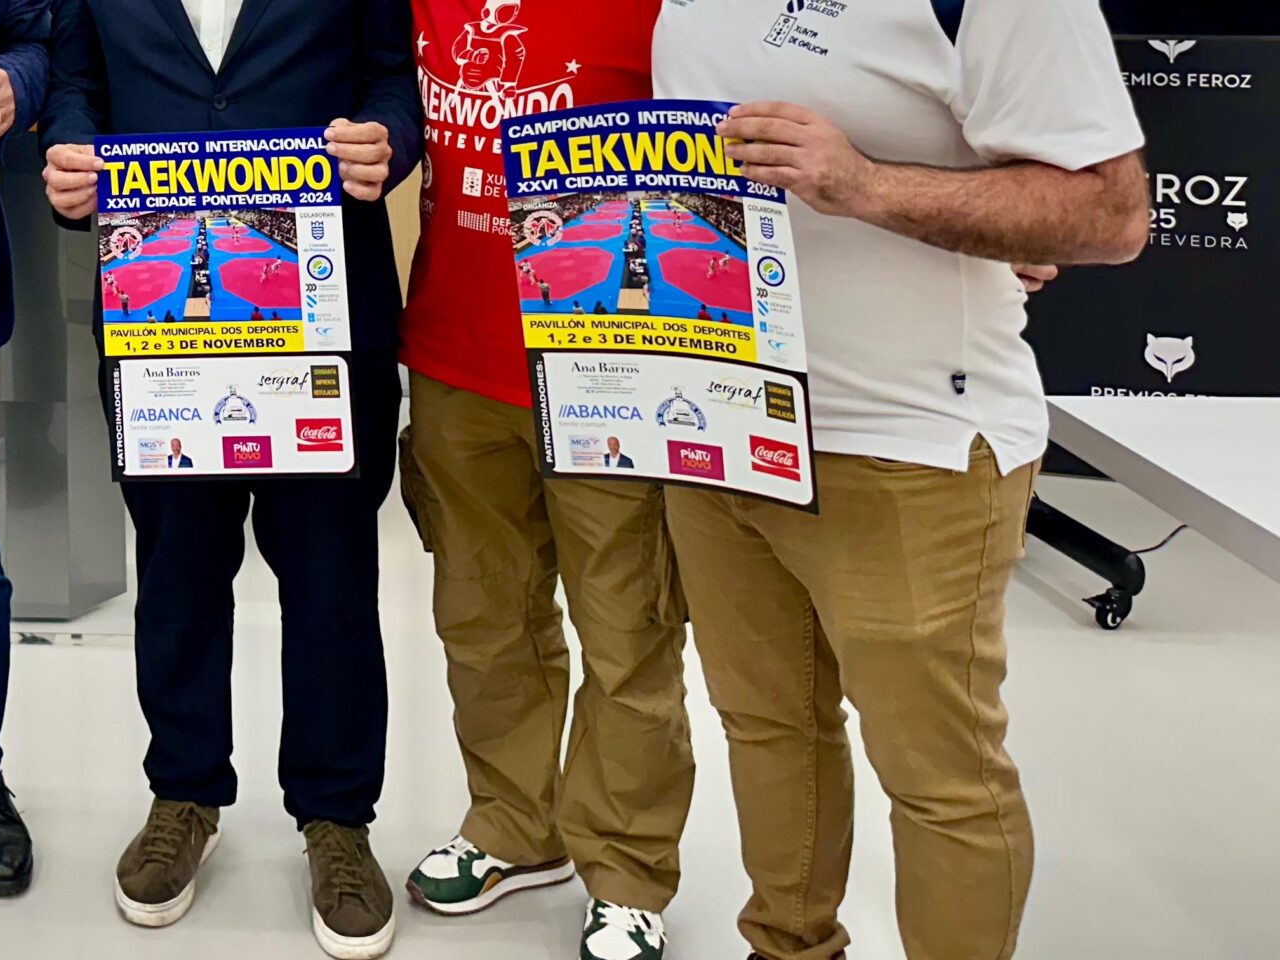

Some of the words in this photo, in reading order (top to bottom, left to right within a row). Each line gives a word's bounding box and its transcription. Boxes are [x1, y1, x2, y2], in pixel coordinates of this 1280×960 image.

[806, 3, 839, 18] GALEGO
[788, 36, 799, 45] DE
[794, 25, 818, 38] XUNTA
[1187, 73, 1252, 88] FEROZ
[508, 112, 630, 139] CAMPIONATO
[637, 110, 727, 127] INTERNAC
[100, 142, 199, 156] CAMPIONATO
[206, 137, 327, 154] INTERNACIONAL
[424, 125, 502, 154] ONTEVE
[510, 131, 744, 179] TAEKWON
[103, 154, 332, 196] TAEKWONDO
[485, 186, 500, 197] DE
[517, 178, 558, 194] XXVI
[564, 175, 628, 190] CIDADE
[635, 172, 740, 192] PONTEVEDRA
[746, 181, 779, 199] 2024
[1156, 173, 1248, 206] ROZ
[106, 198, 140, 209] XXVI
[145, 196, 196, 208] CIDADE
[202, 193, 293, 206] PONTEVEDRA
[299, 192, 333, 204] 2024
[1149, 233, 1248, 249] TEVEDRA
[110, 326, 157, 337] PAVILLÓN
[161, 327, 217, 337] MUNICIPAL
[221, 326, 243, 335] DOS
[247, 324, 299, 335] DEPORTES
[530, 317, 586, 331] PAVILLÓN
[590, 320, 658, 331] MUNICIPAL
[662, 321, 688, 333] DOS
[692, 324, 751, 341] DEPORTES
[141, 341, 150, 351] 2
[153, 343, 163, 351] e
[167, 340, 176, 350] 3
[180, 340, 199, 350] DE
[202, 337, 286, 349] NOVEMBRO
[567, 333, 578, 344] 2
[582, 335, 593, 344] e
[597, 333, 608, 344] 3
[613, 333, 636, 345] DE
[641, 334, 737, 355] NOVEMBRO
[142, 367, 164, 378] Ana
[165, 368, 201, 378] Barros
[571, 361, 597, 374] Ana
[598, 363, 640, 375] Barros
[257, 371, 309, 391] sergraf
[706, 378, 764, 403] sergraf
[113, 367, 125, 467] PATROCINADORES:
[535, 360, 555, 463] PATROCINADORES:
